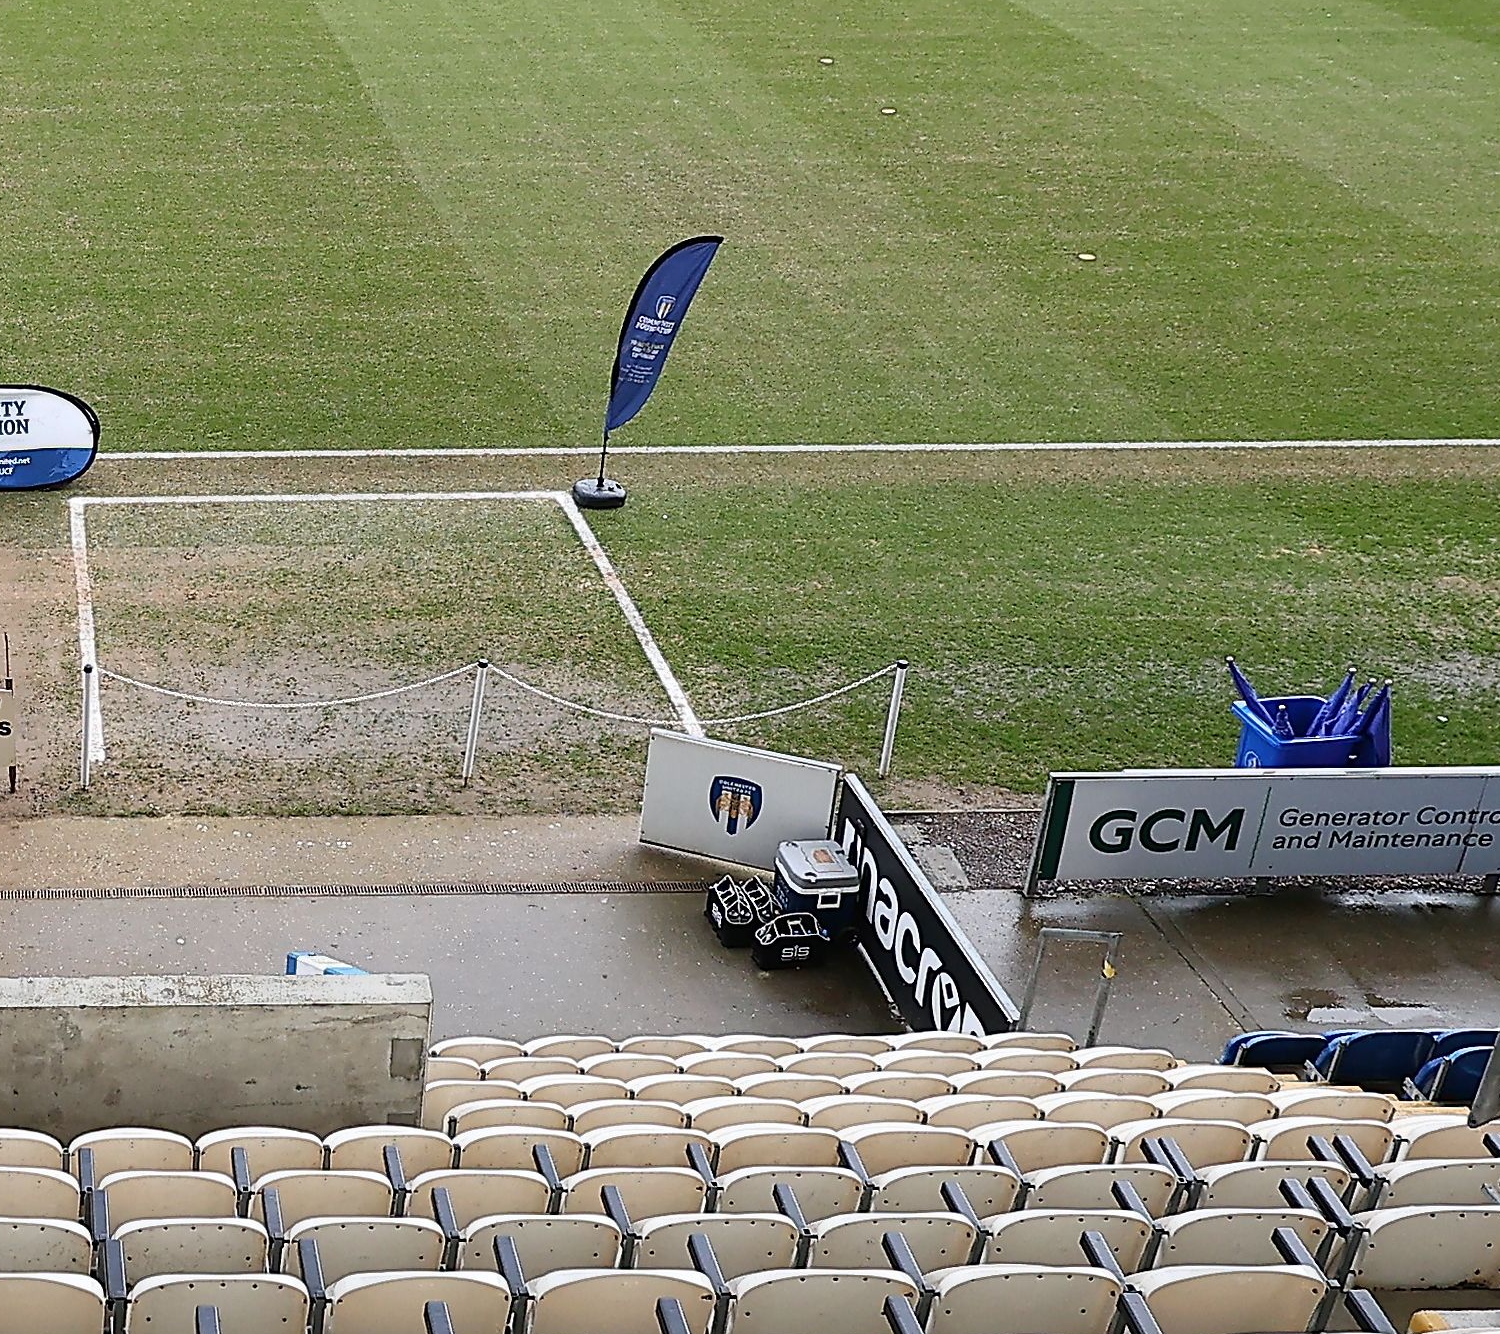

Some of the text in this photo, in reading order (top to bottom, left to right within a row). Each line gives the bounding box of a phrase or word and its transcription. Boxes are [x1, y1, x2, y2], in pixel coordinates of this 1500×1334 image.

[1277, 806, 1411, 829] Generator
[1087, 807, 1247, 855] GCM
[1271, 829, 1494, 851] and Maintenance
